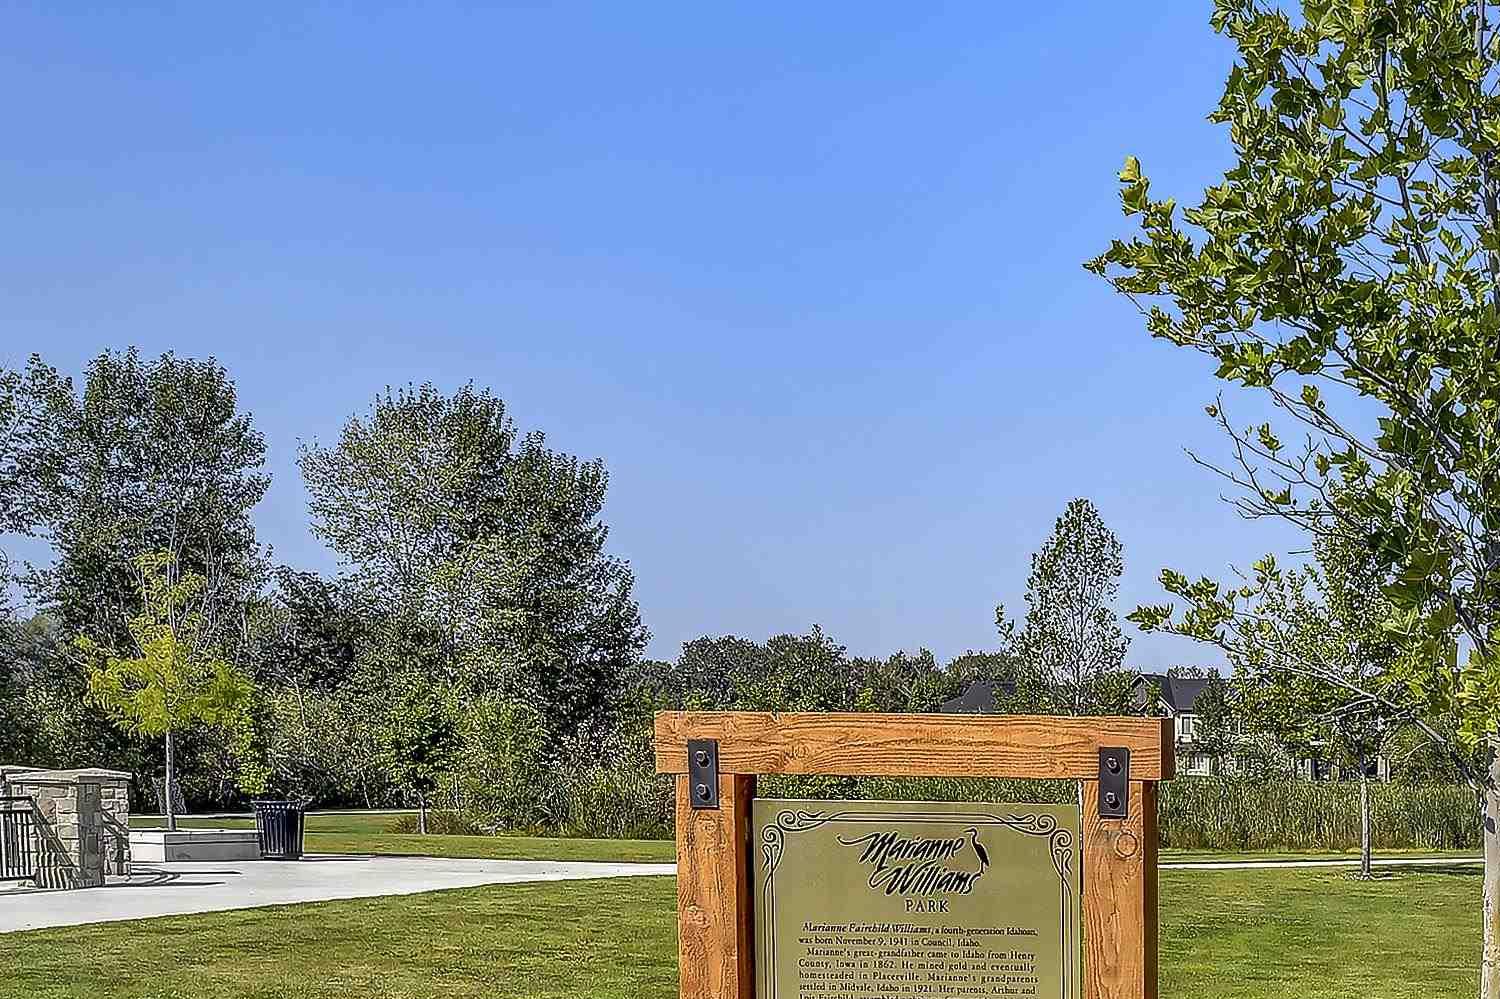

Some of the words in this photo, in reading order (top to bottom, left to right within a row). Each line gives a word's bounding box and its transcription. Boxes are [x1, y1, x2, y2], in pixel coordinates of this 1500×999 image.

[838, 830, 965, 866] Marianne
[869, 860, 981, 896] Williams
[904, 899, 950, 913] PARK
[802, 922, 846, 932] Marianne
[849, 923, 888, 933] Fairchild
[892, 924, 933, 935] Williams,
[940, 925, 1005, 937] fourth-generation
[814, 935, 833, 944] born
[835, 935, 876, 945] November
[920, 937, 954, 948] Council,
[957, 938, 981, 947] Idaho.
[807, 946, 850, 956] Marianne's
[853, 947, 924, 960] great-grandfather
[962, 950, 985, 959] Idaho
[988, 950, 1007, 959] from
[1010, 951, 1034, 962] Henry
[798, 958, 831, 970] County,
[836, 959, 855, 968] Iowa
[901, 960, 914, 969] He
[917, 961, 944, 970] mined
[948, 961, 967, 972] gold
[990, 962, 1035, 974] eventually
[799, 969, 854, 979] homesteaded
[927, 972, 975, 982] Marianne's
[980, 973, 1038, 986] grandparents
[799, 981, 825, 990] settled
[839, 982, 874, 993] Midvale,
[876, 982, 900, 992] Idaho
[938, 984, 954, 993] Her
[957, 985, 988, 996] parents,
[990, 985, 1018, 994] Arthur
